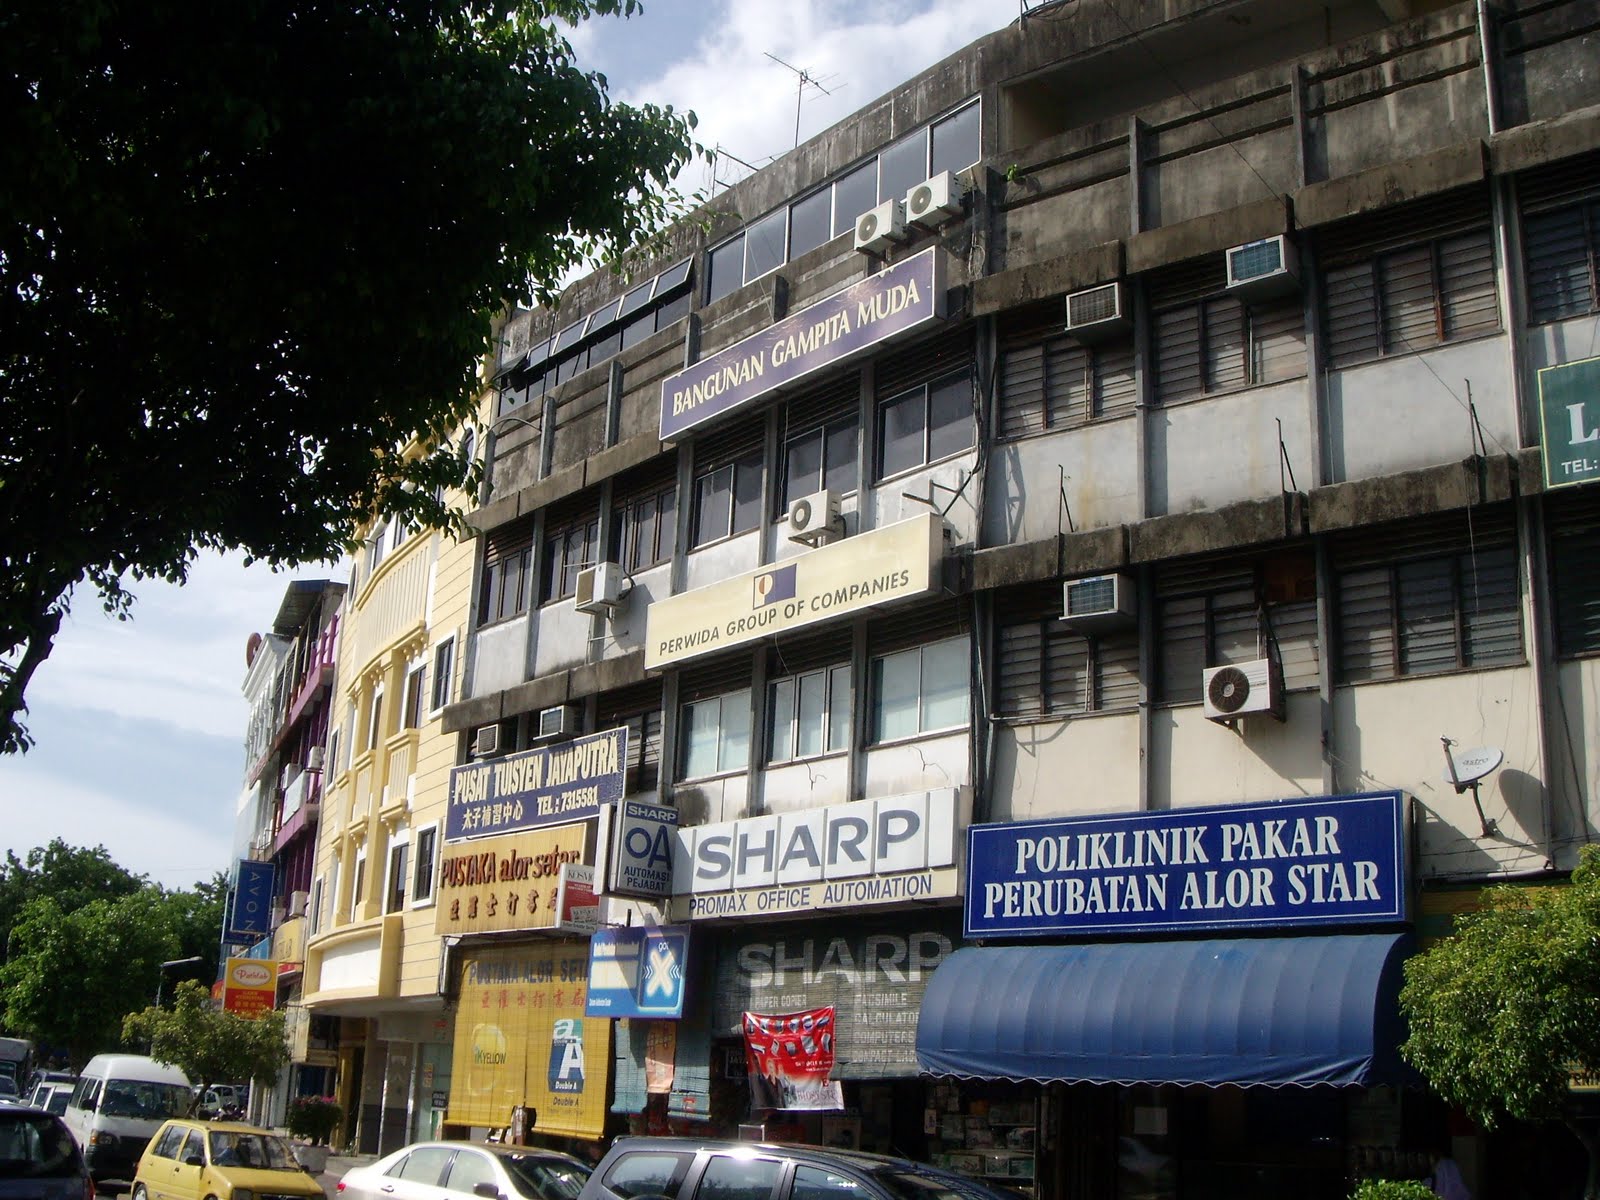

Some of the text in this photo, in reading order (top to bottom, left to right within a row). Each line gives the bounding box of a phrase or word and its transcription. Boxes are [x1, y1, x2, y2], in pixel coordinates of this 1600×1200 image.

[673, 278, 920, 416] BANGUNAN GAMPITA MUDA
[1561, 458, 1598, 475] TEL:
[659, 569, 909, 656] PERWIDA GROUP OF COMPANIES
[453, 734, 619, 806] PUSAT TUISYEN JAYAPUTRA
[1462, 757, 1489, 766] astro
[628, 804, 677, 822] SHARP
[625, 825, 672, 871] OA
[696, 809, 921, 880] SHARP
[1015, 816, 1341, 874] POLIKLINIK PAKAR
[441, 851, 496, 888] PUSTAKA
[499, 849, 533, 882] alor
[624, 865, 670, 882] AUTOMASI
[627, 876, 666, 892] PEJABAT
[983, 861, 1381, 918] PERUBATAN ALOR STAR
[245, 871, 260, 930] AVON
[689, 874, 932, 917] PROMAX OFFICE AUTOMATION
[736, 931, 952, 988] SHARP
[854, 993, 907, 1006] FACSIMILE
[553, 1097, 574, 1107] Double
[555, 1080, 577, 1090] Double A
